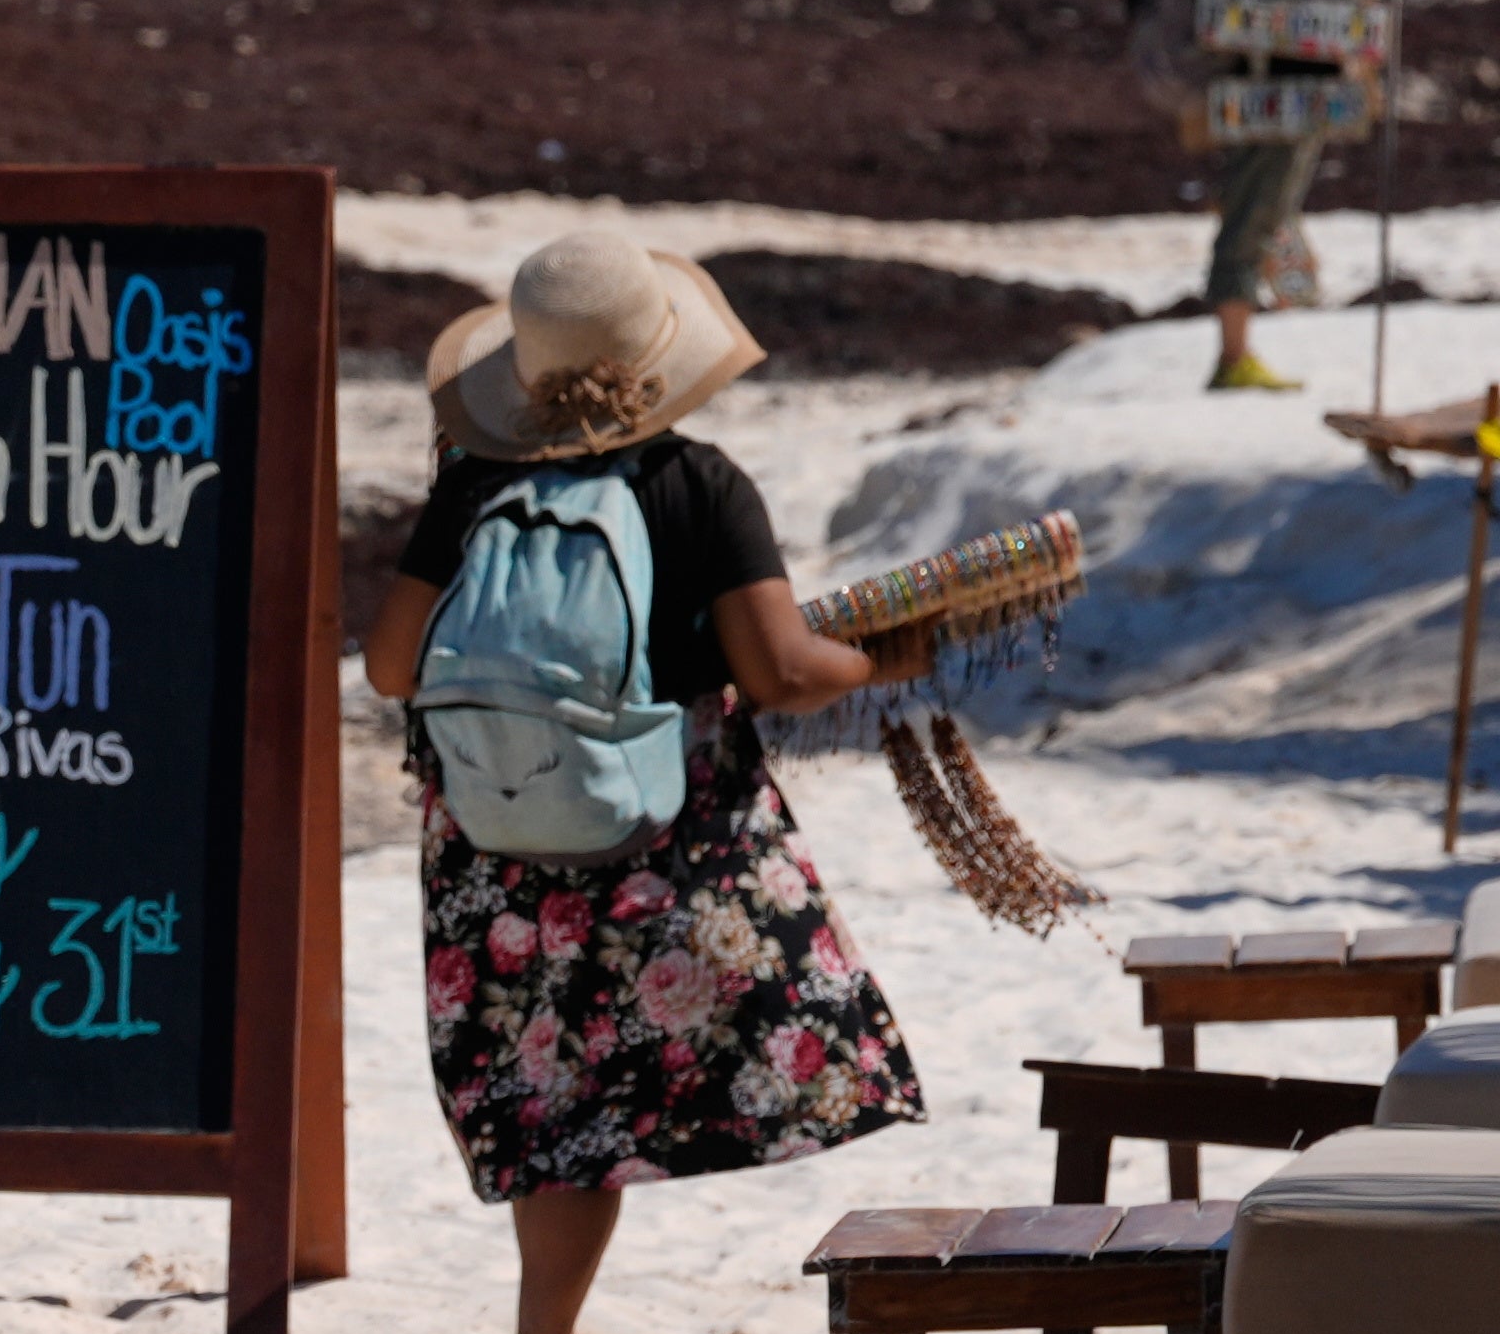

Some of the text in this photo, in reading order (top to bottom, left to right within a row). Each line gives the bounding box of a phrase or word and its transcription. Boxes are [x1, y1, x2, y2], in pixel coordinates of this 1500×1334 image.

[113, 273, 253, 374] Oasis
[30, 364, 220, 549] Hour
[106, 361, 219, 458] Pool
[31, 892, 182, 1039] 31st
